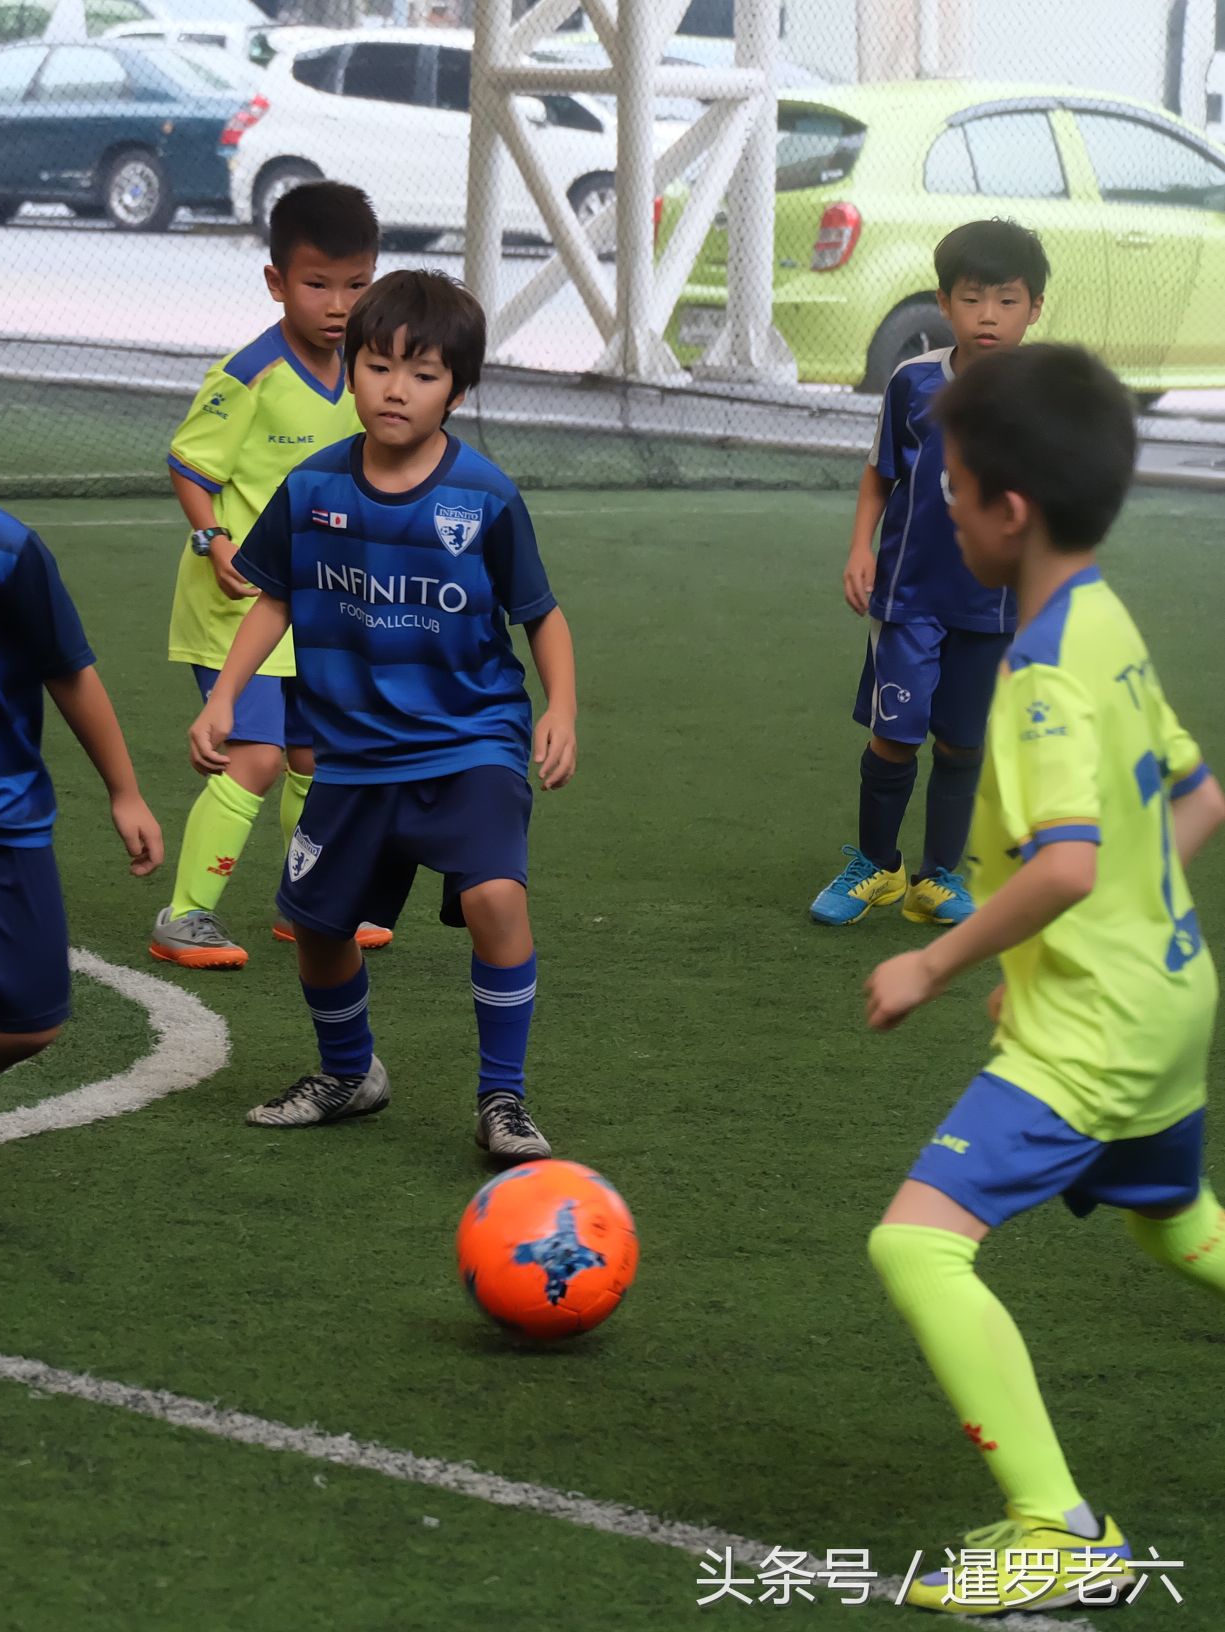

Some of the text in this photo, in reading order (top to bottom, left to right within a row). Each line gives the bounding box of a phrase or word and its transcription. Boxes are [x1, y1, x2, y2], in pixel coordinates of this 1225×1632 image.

[201, 403, 229, 420] ELME
[267, 434, 315, 445] KELME
[439, 508, 479, 520] INFINITO
[316, 560, 468, 613] INFINITO
[339, 601, 440, 634] FOOTBALLCLUB
